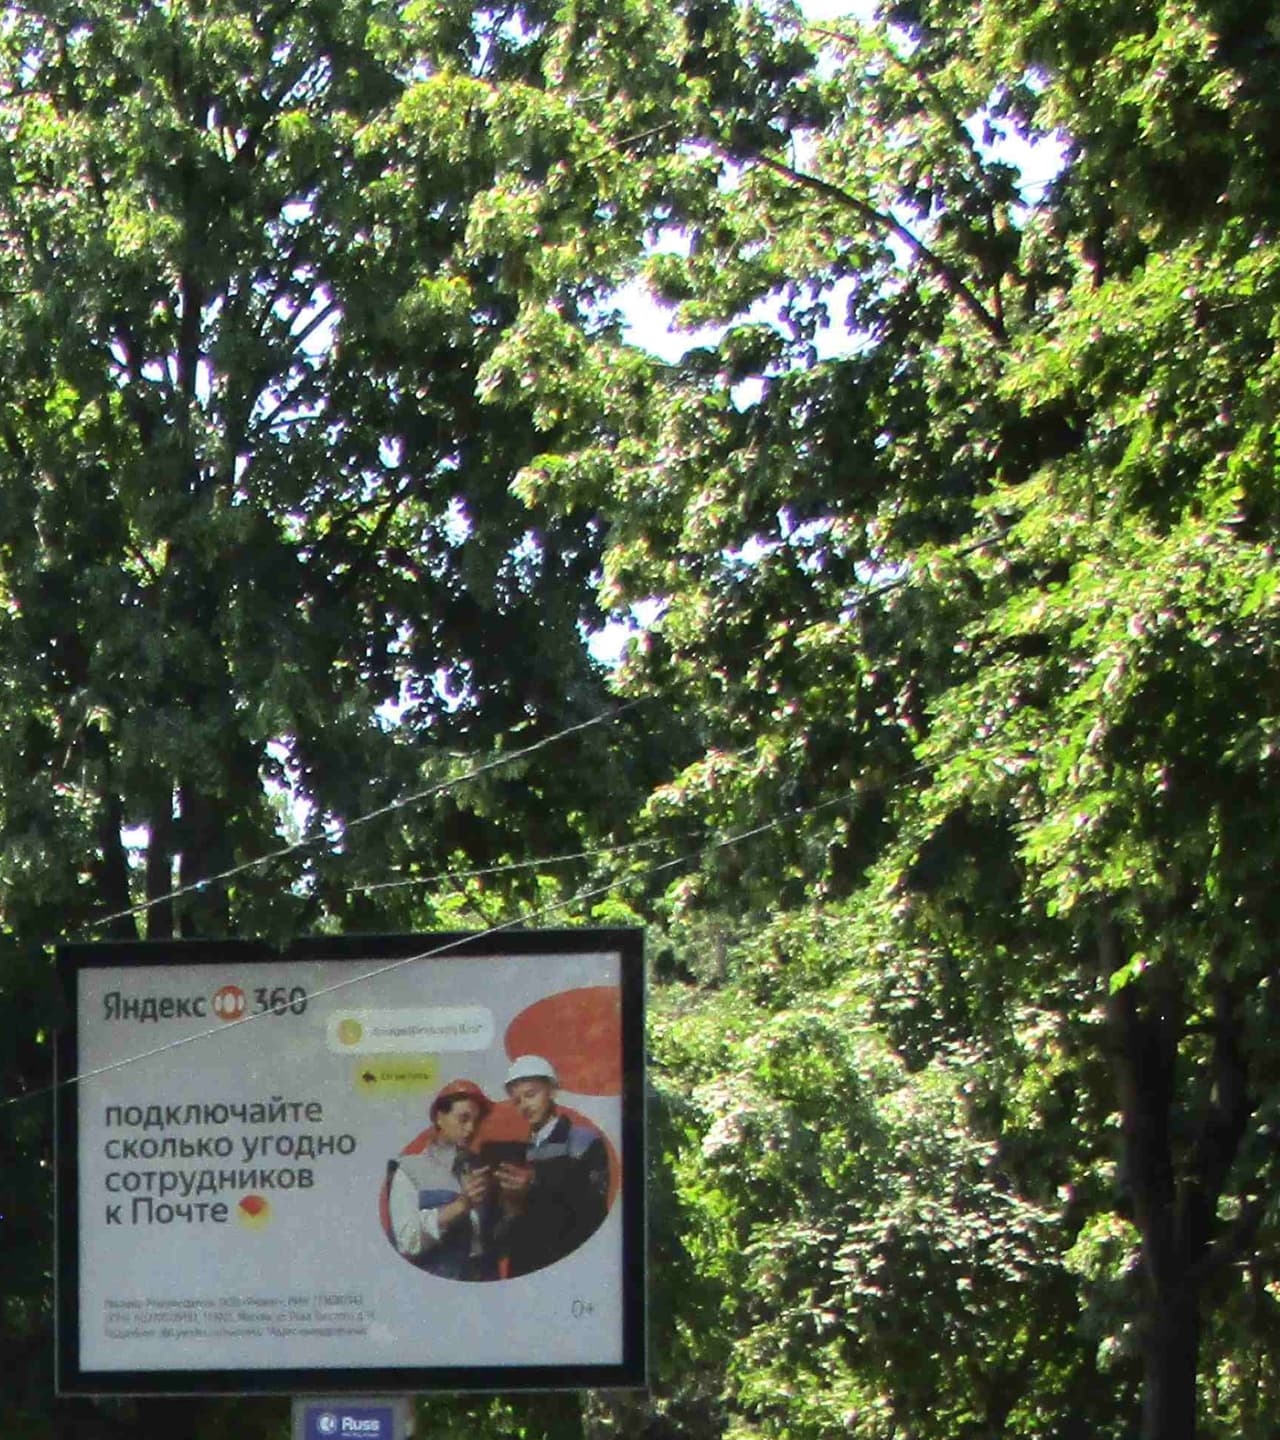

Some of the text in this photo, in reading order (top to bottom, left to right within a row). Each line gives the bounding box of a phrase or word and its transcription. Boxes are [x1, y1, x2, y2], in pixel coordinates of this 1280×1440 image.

[104, 986, 307, 1022] Яндекс 360
[105, 1096, 323, 1130] подключайте
[104, 1134, 357, 1163] сколько угодно
[104, 1167, 315, 1197] сотрудников
[106, 1197, 229, 1225] к Почте
[341, 1416, 381, 1432] Russ
